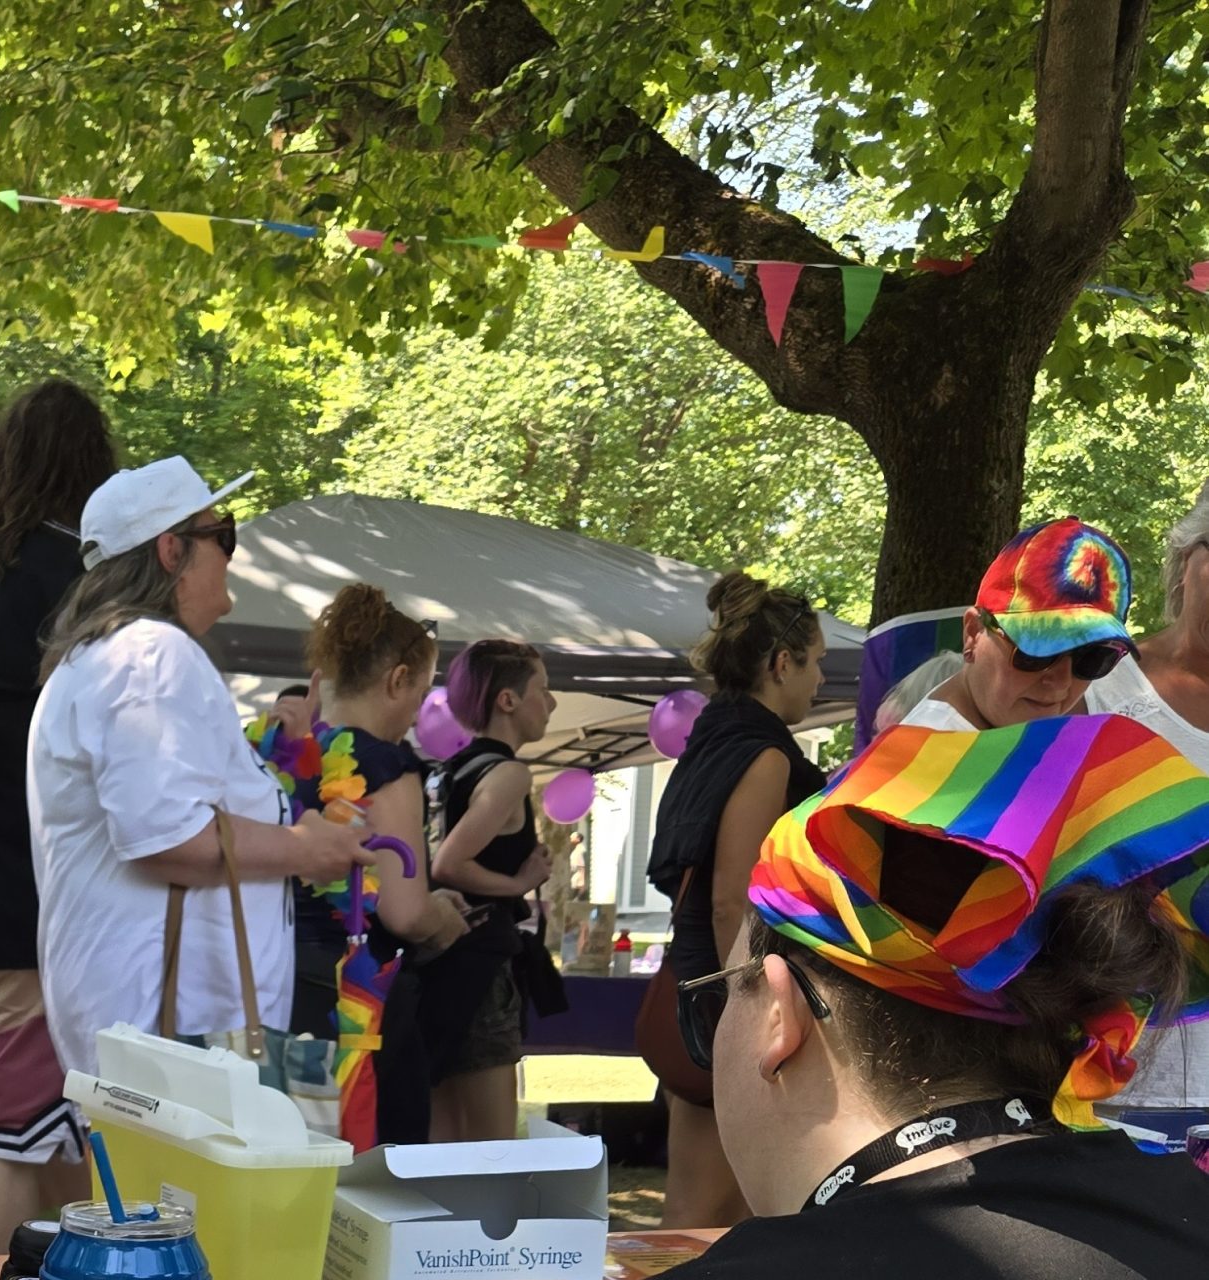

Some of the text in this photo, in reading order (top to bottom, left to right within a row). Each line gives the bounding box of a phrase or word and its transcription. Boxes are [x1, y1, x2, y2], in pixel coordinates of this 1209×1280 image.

[905, 1119, 951, 1142] thrive
[819, 1167, 852, 1198] thrive
[519, 1246, 582, 1269] Syringe
